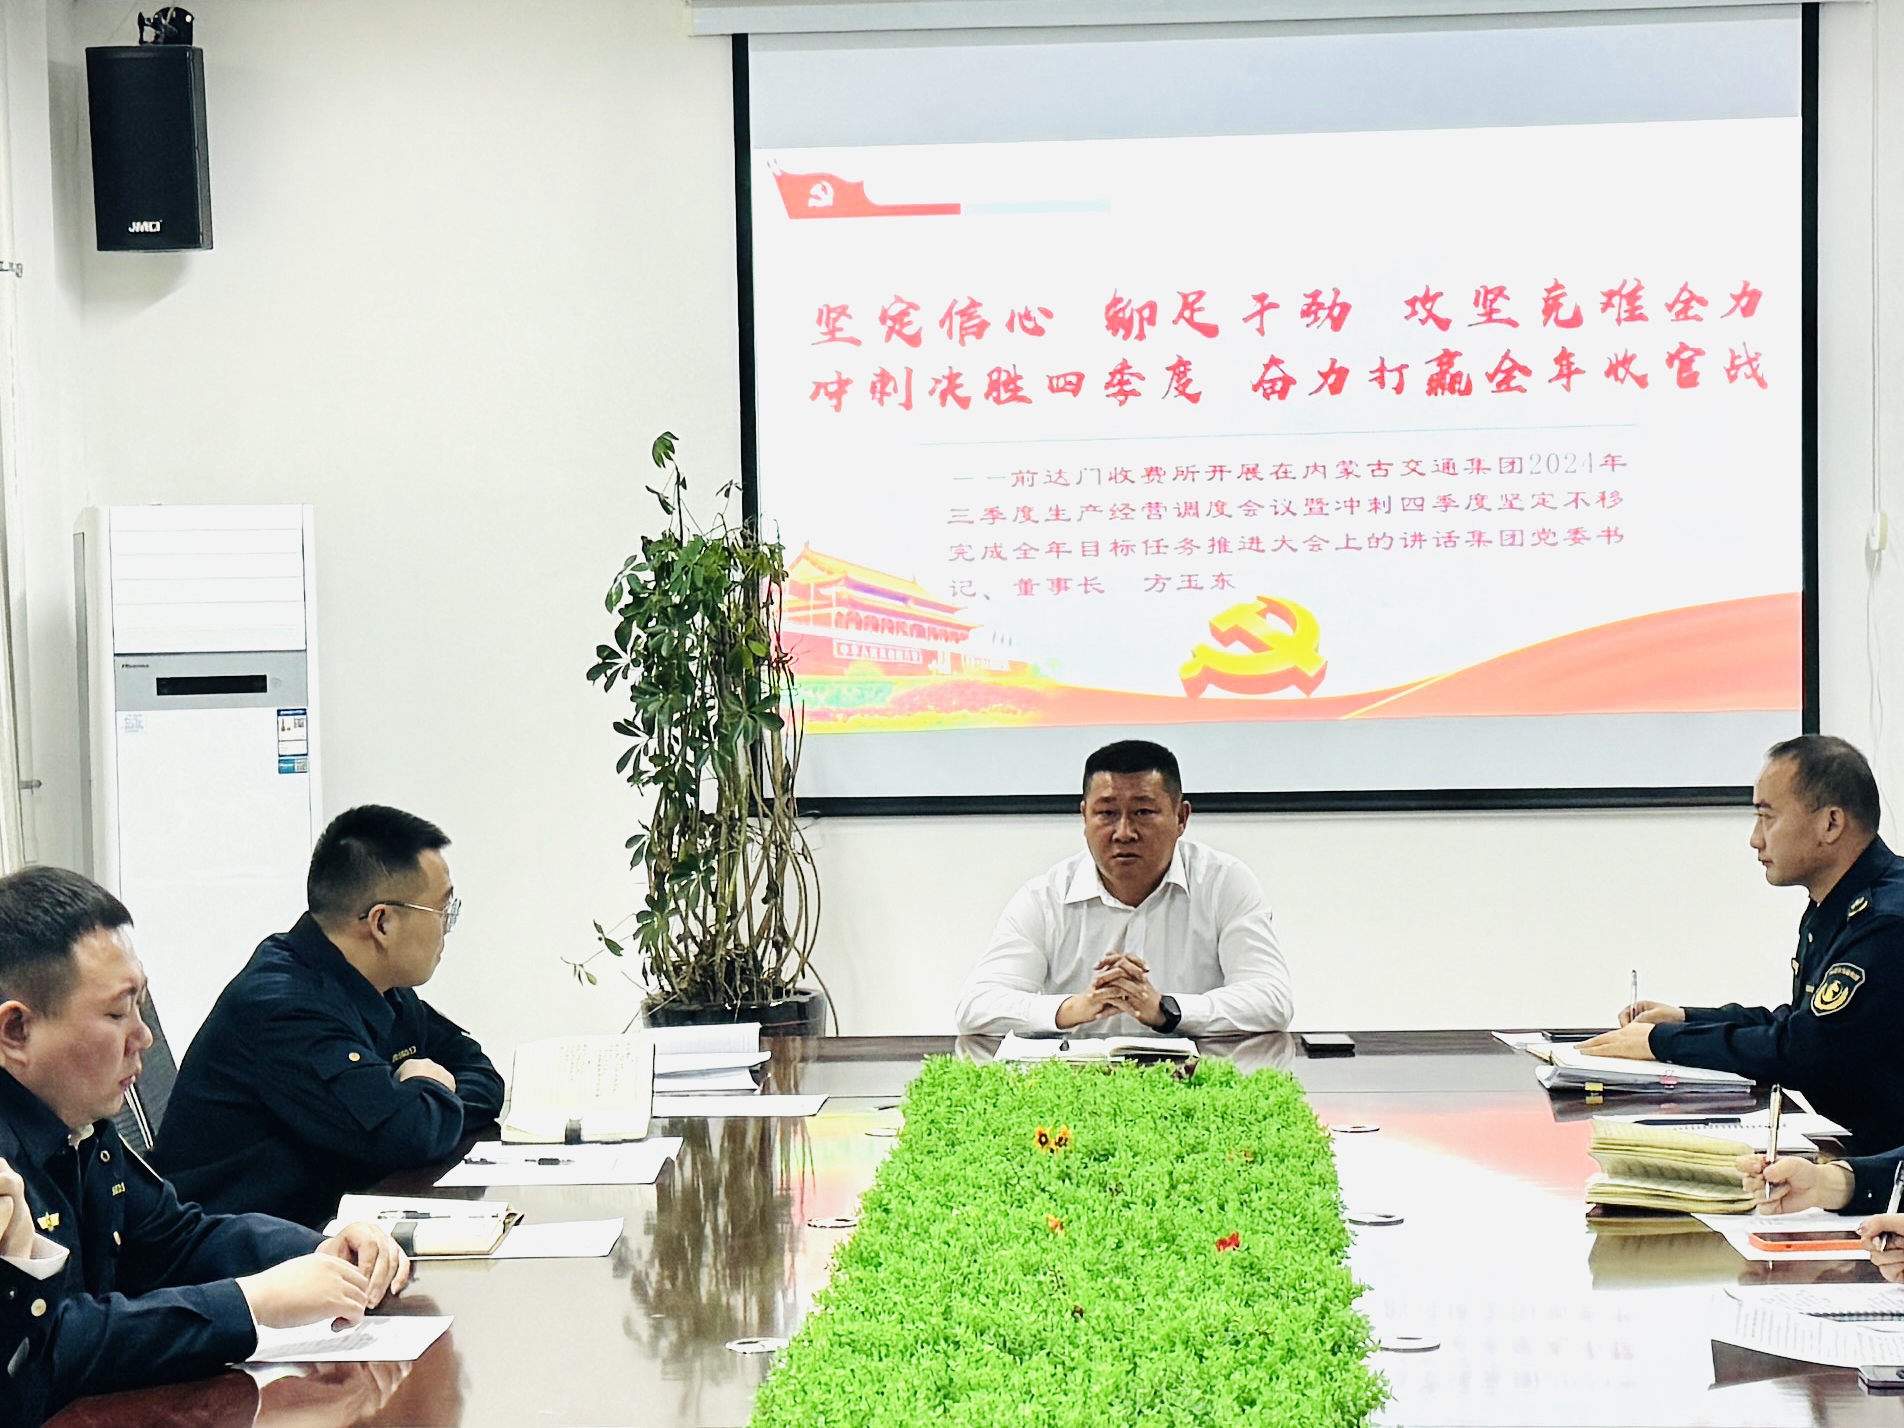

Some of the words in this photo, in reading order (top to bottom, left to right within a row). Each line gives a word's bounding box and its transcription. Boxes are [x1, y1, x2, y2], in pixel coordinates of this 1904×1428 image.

[810, 293, 1055, 349] 坚定信心
[1403, 277, 1764, 333] 攻坚克难全力
[808, 354, 1203, 414] 冲刺决胜四季度
[1250, 341, 1770, 402] 奋力打赢全年收官战
[946, 490, 1625, 525] 三季度生产经营调度会议暨冲刺四季度坚定不移
[946, 525, 1626, 563] 完成全年目标任务推进大会上的讲话集团党委书
[948, 575, 1106, 602] 记、董事长
